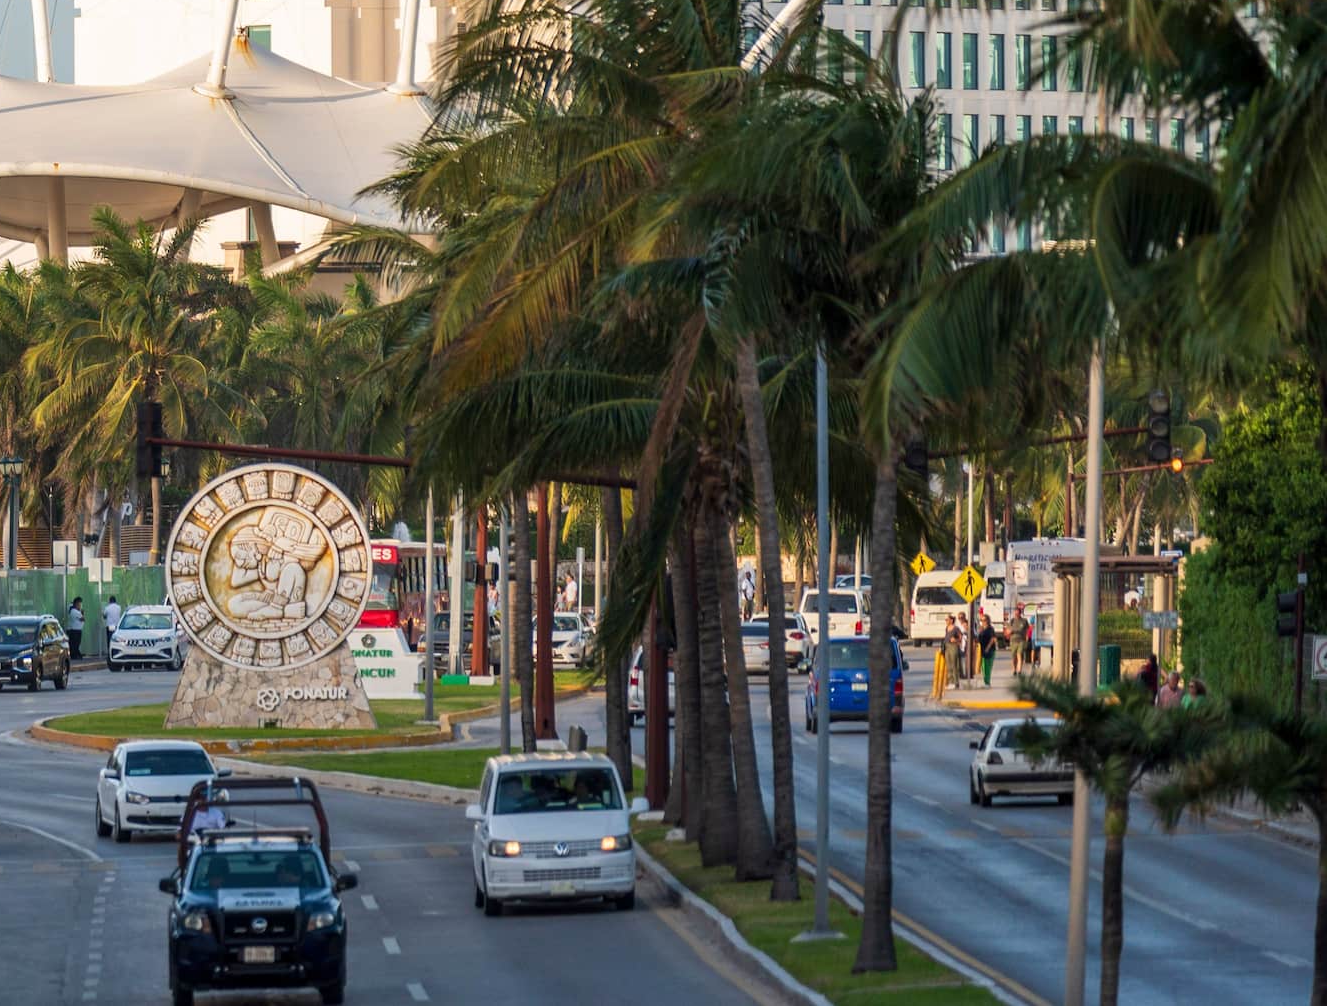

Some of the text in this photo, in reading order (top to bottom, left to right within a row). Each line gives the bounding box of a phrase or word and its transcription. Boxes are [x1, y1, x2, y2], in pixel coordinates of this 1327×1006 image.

[351, 649, 394, 658] ONATUR
[359, 668, 396, 678] NCUN
[284, 686, 347, 700] FONATUR
